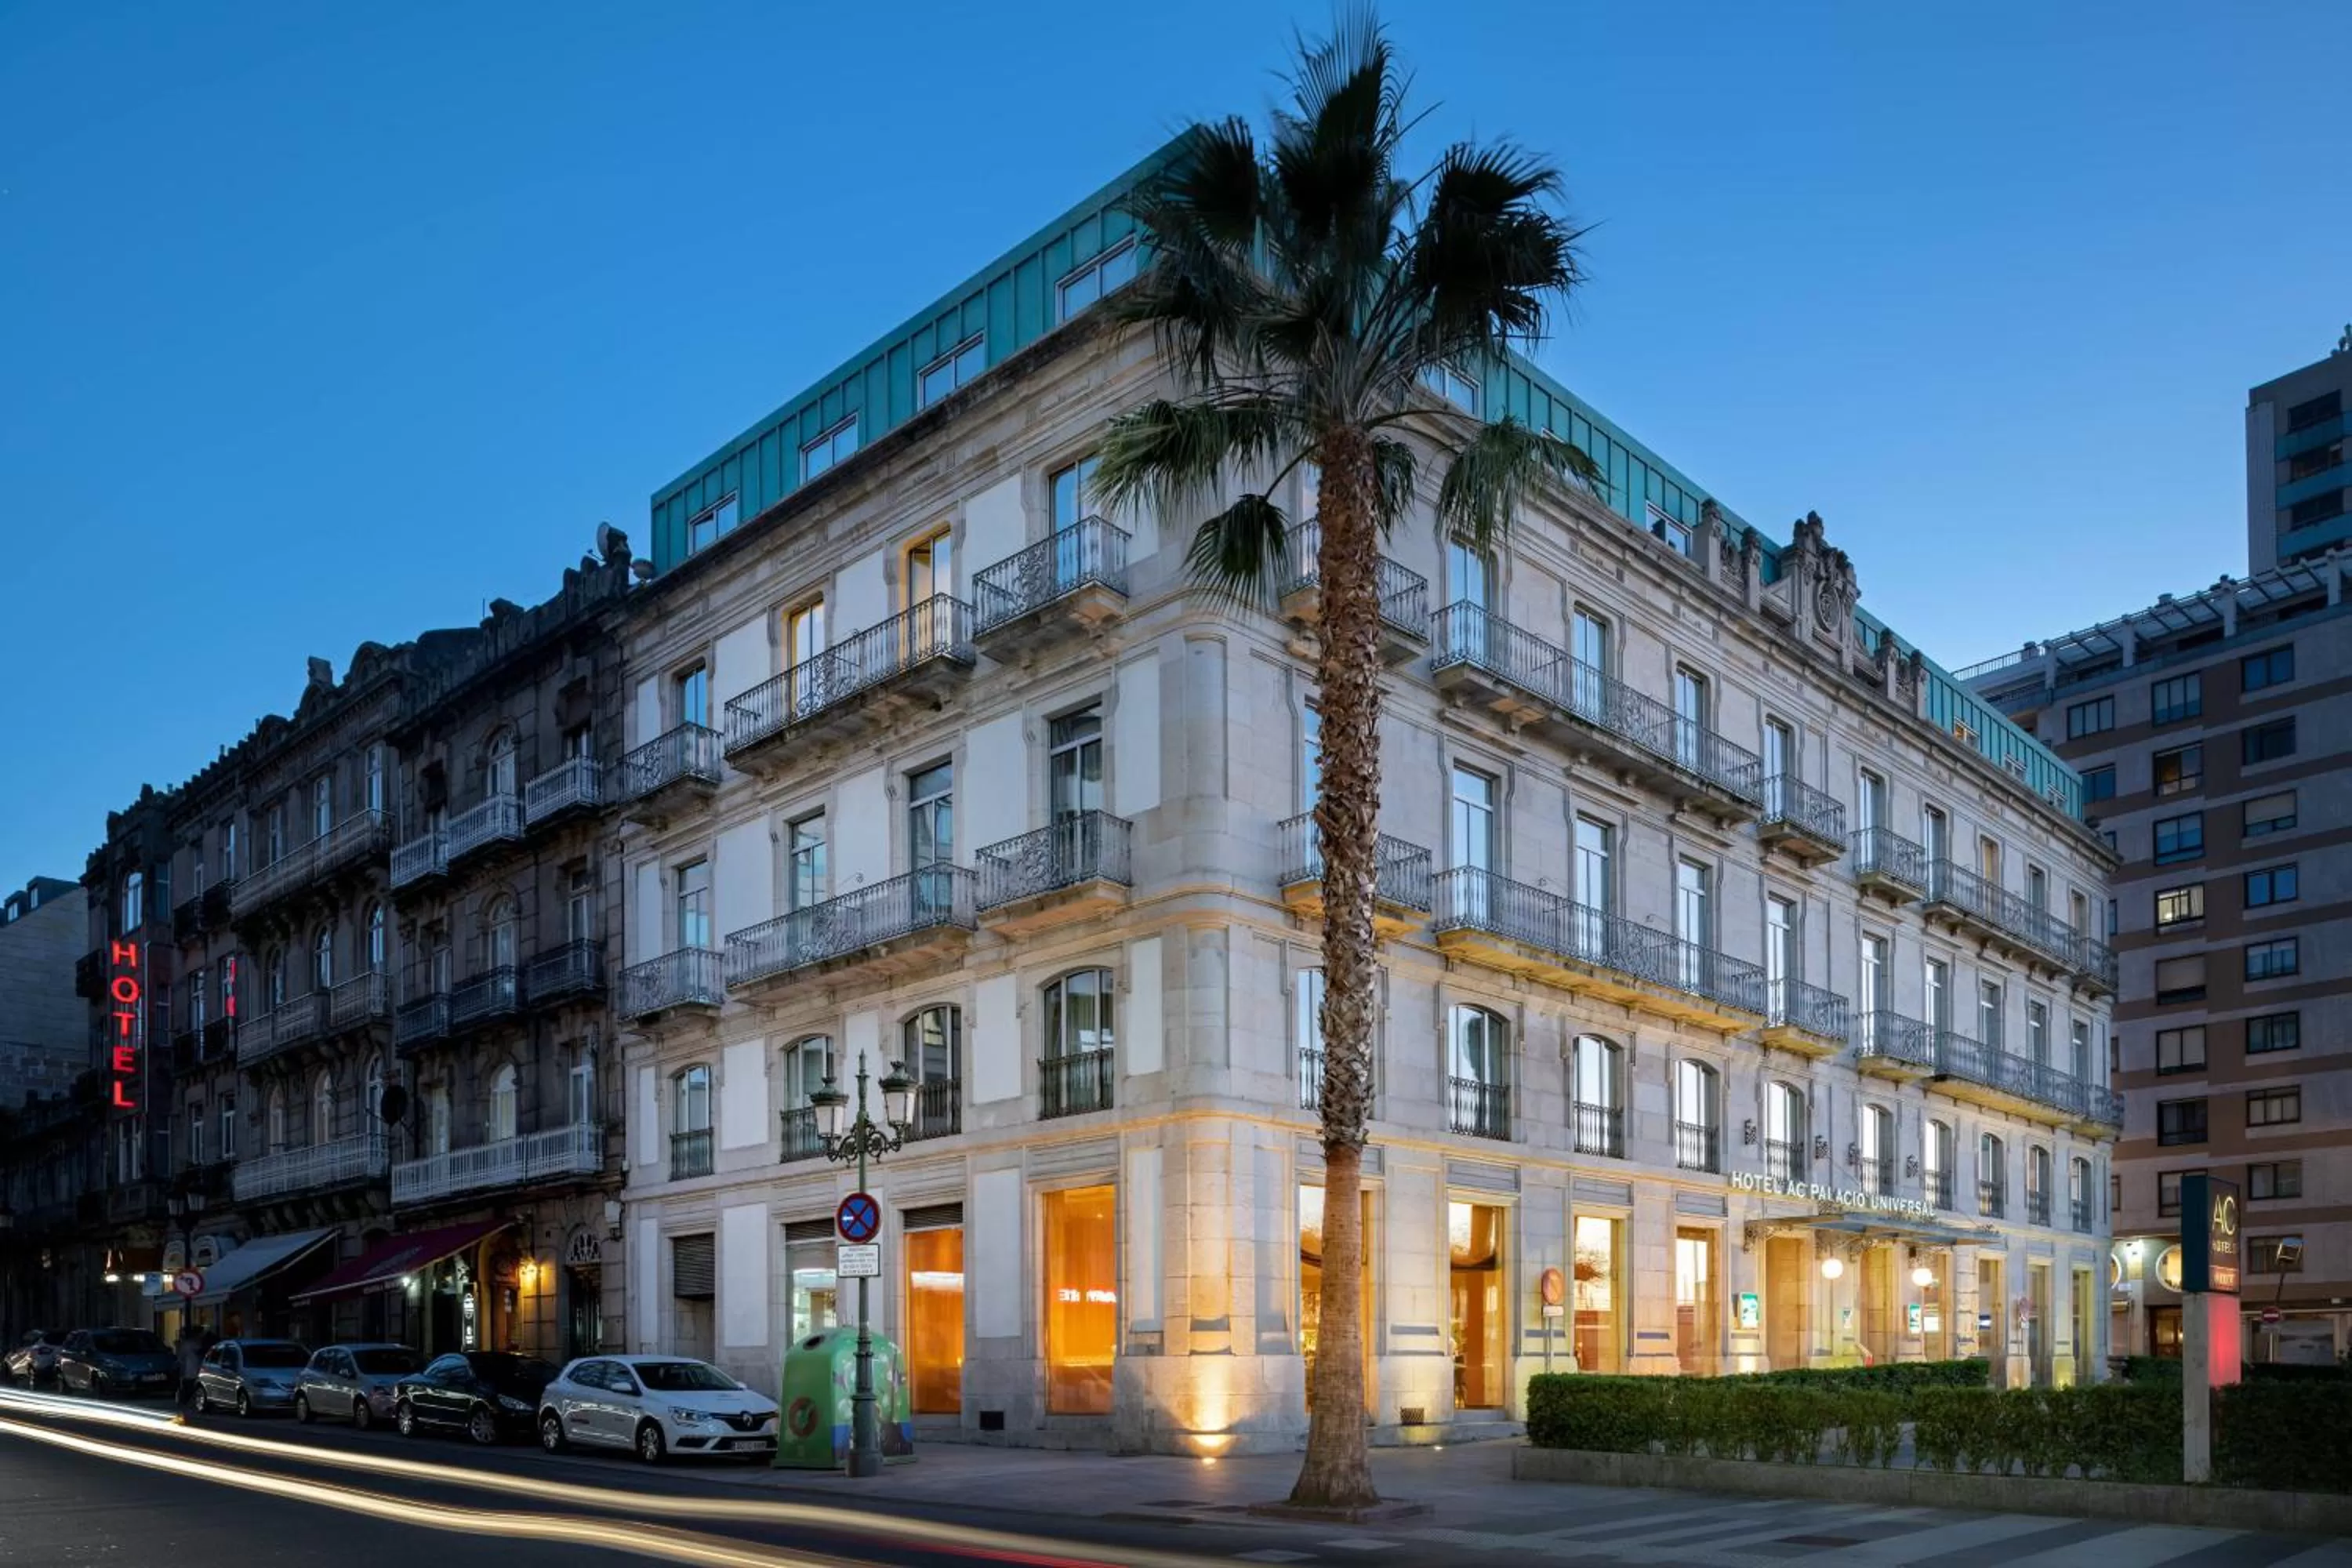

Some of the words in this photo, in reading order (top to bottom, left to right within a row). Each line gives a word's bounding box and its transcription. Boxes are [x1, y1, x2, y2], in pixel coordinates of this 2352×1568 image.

[111, 941, 140, 1107] HOTEL
[1732, 1171, 1782, 1193] HOTEL
[1787, 1180, 1807, 1198] AC
[1810, 1183, 1865, 1207] PALACIO
[1871, 1194, 1936, 1217] UNIVERSAL
[2212, 1194, 2235, 1236] AC
